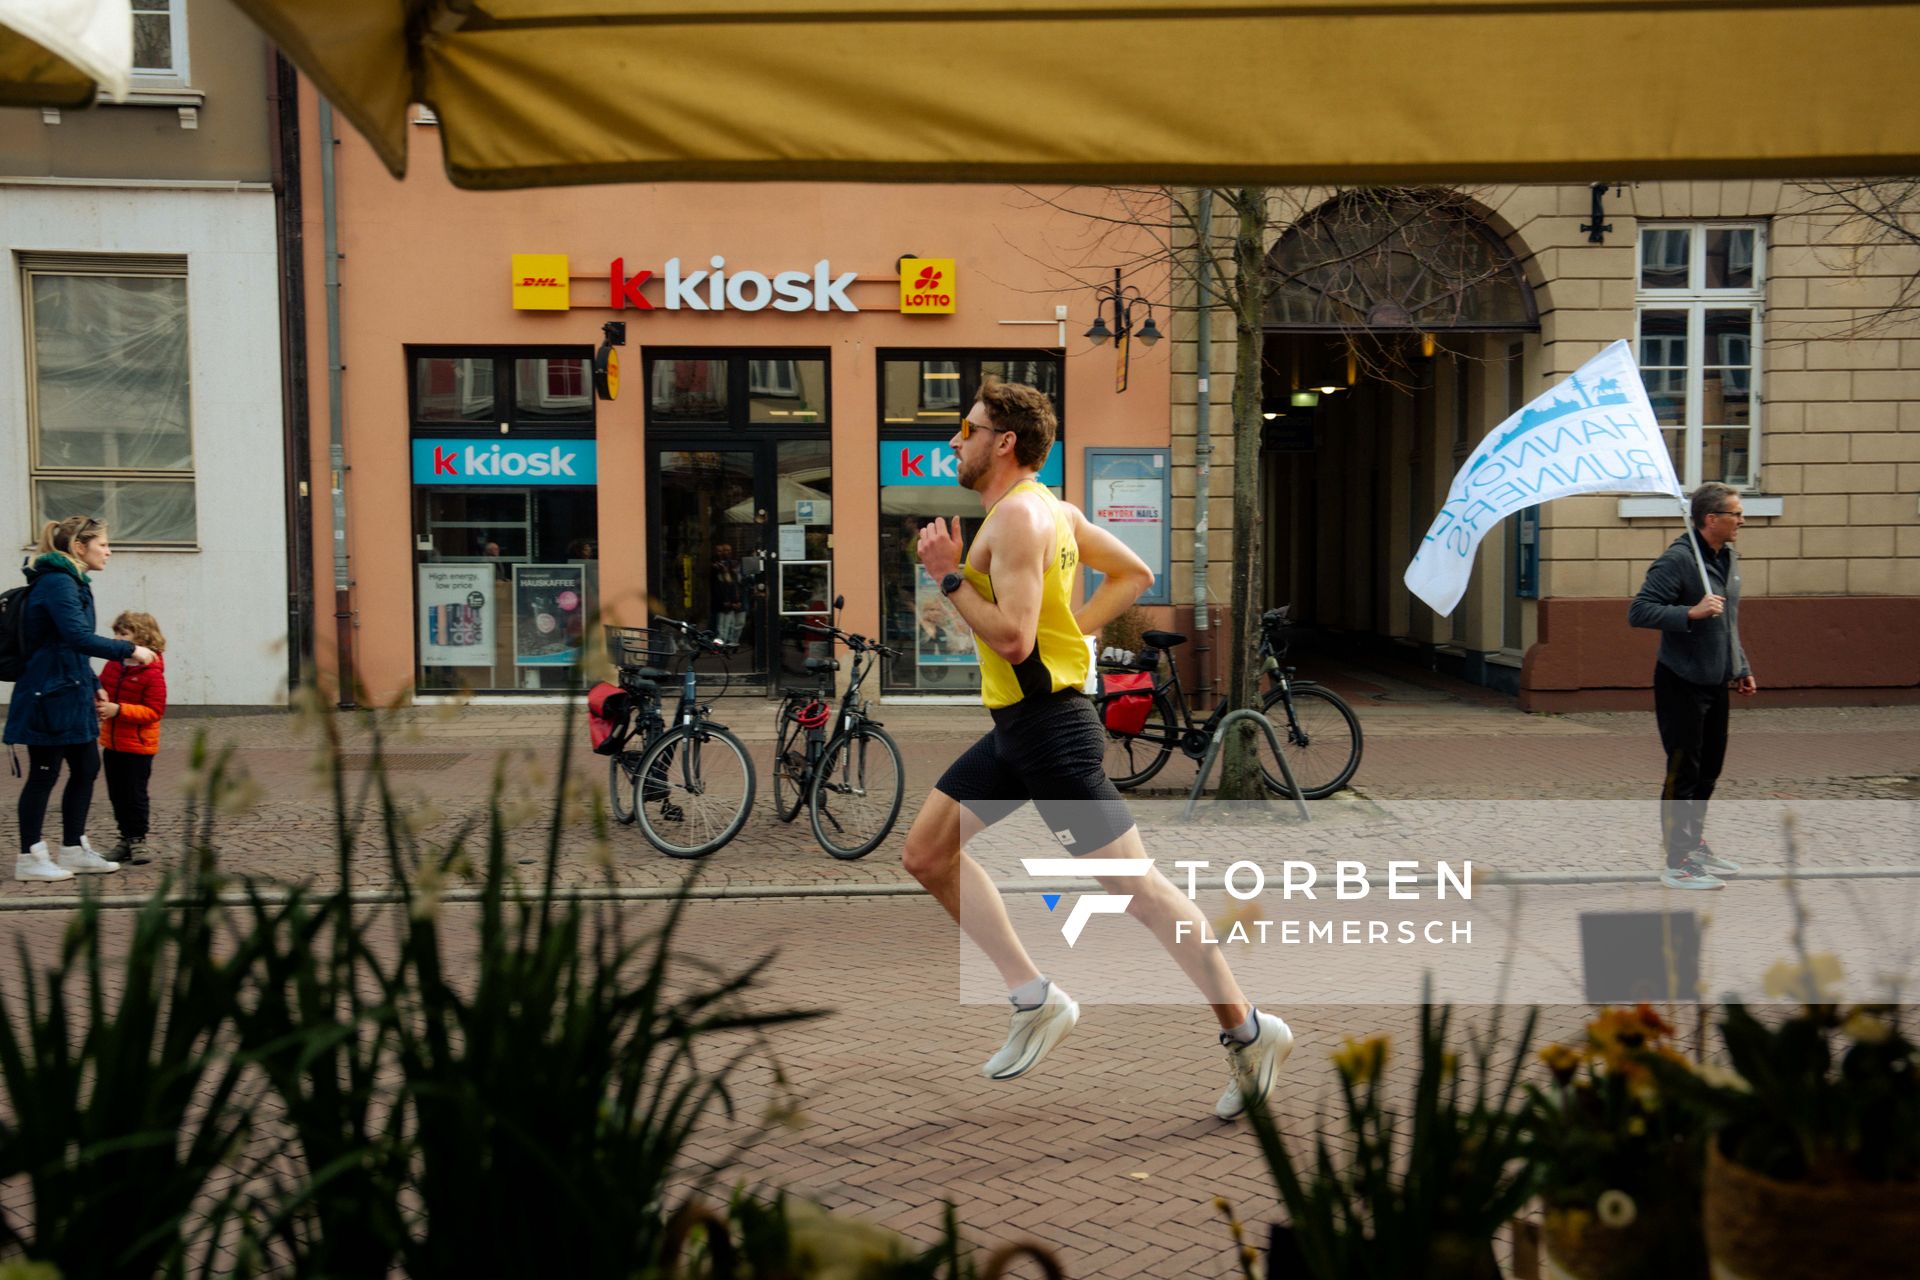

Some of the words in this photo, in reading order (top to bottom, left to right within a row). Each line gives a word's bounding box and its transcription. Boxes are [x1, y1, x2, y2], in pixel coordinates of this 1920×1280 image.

[522, 277, 558, 286] DHL
[664, 255, 859, 312] kiosk
[905, 294, 950, 306] LOTTO
[464, 444, 577, 476] kiosk
[428, 573, 448, 581] High
[520, 579, 576, 587] HAUSKAFFEE
